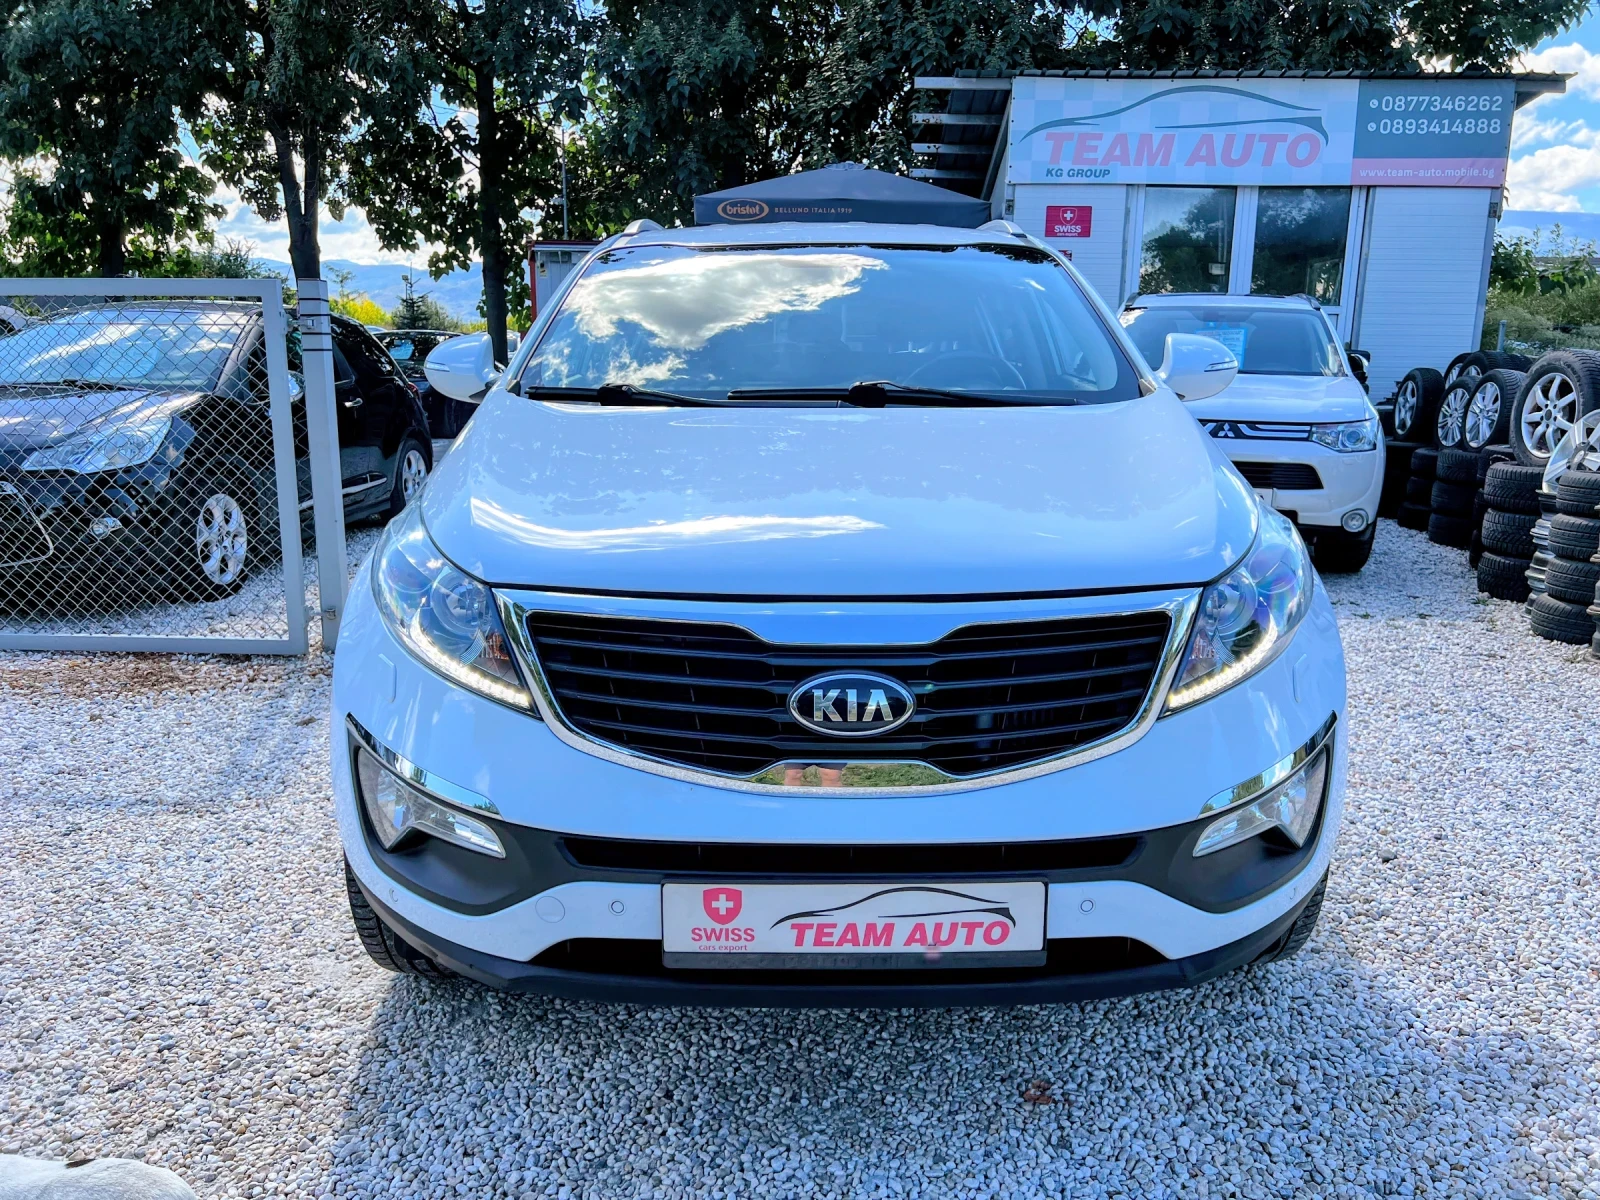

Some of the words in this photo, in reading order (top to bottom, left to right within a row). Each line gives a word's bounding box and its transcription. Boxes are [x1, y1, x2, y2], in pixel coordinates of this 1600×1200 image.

[1381, 95, 1503, 112] 0877346262
[1379, 118, 1501, 135] 0893414888
[1044, 131, 1176, 167] TEAM
[1184, 132, 1322, 168] AUTO
[1045, 167, 1063, 178] KG
[1067, 168, 1111, 179] GROUP
[1359, 167, 1495, 179] www.team-auto.mobile.bg
[726, 203, 760, 215] bristot
[1054, 225, 1082, 233] SWISS
[811, 688, 894, 722] KIA
[691, 927, 756, 942] SWISS
[790, 922, 896, 947] TEAM
[903, 920, 1011, 947] AUTO
[718, 943, 748, 953] export
